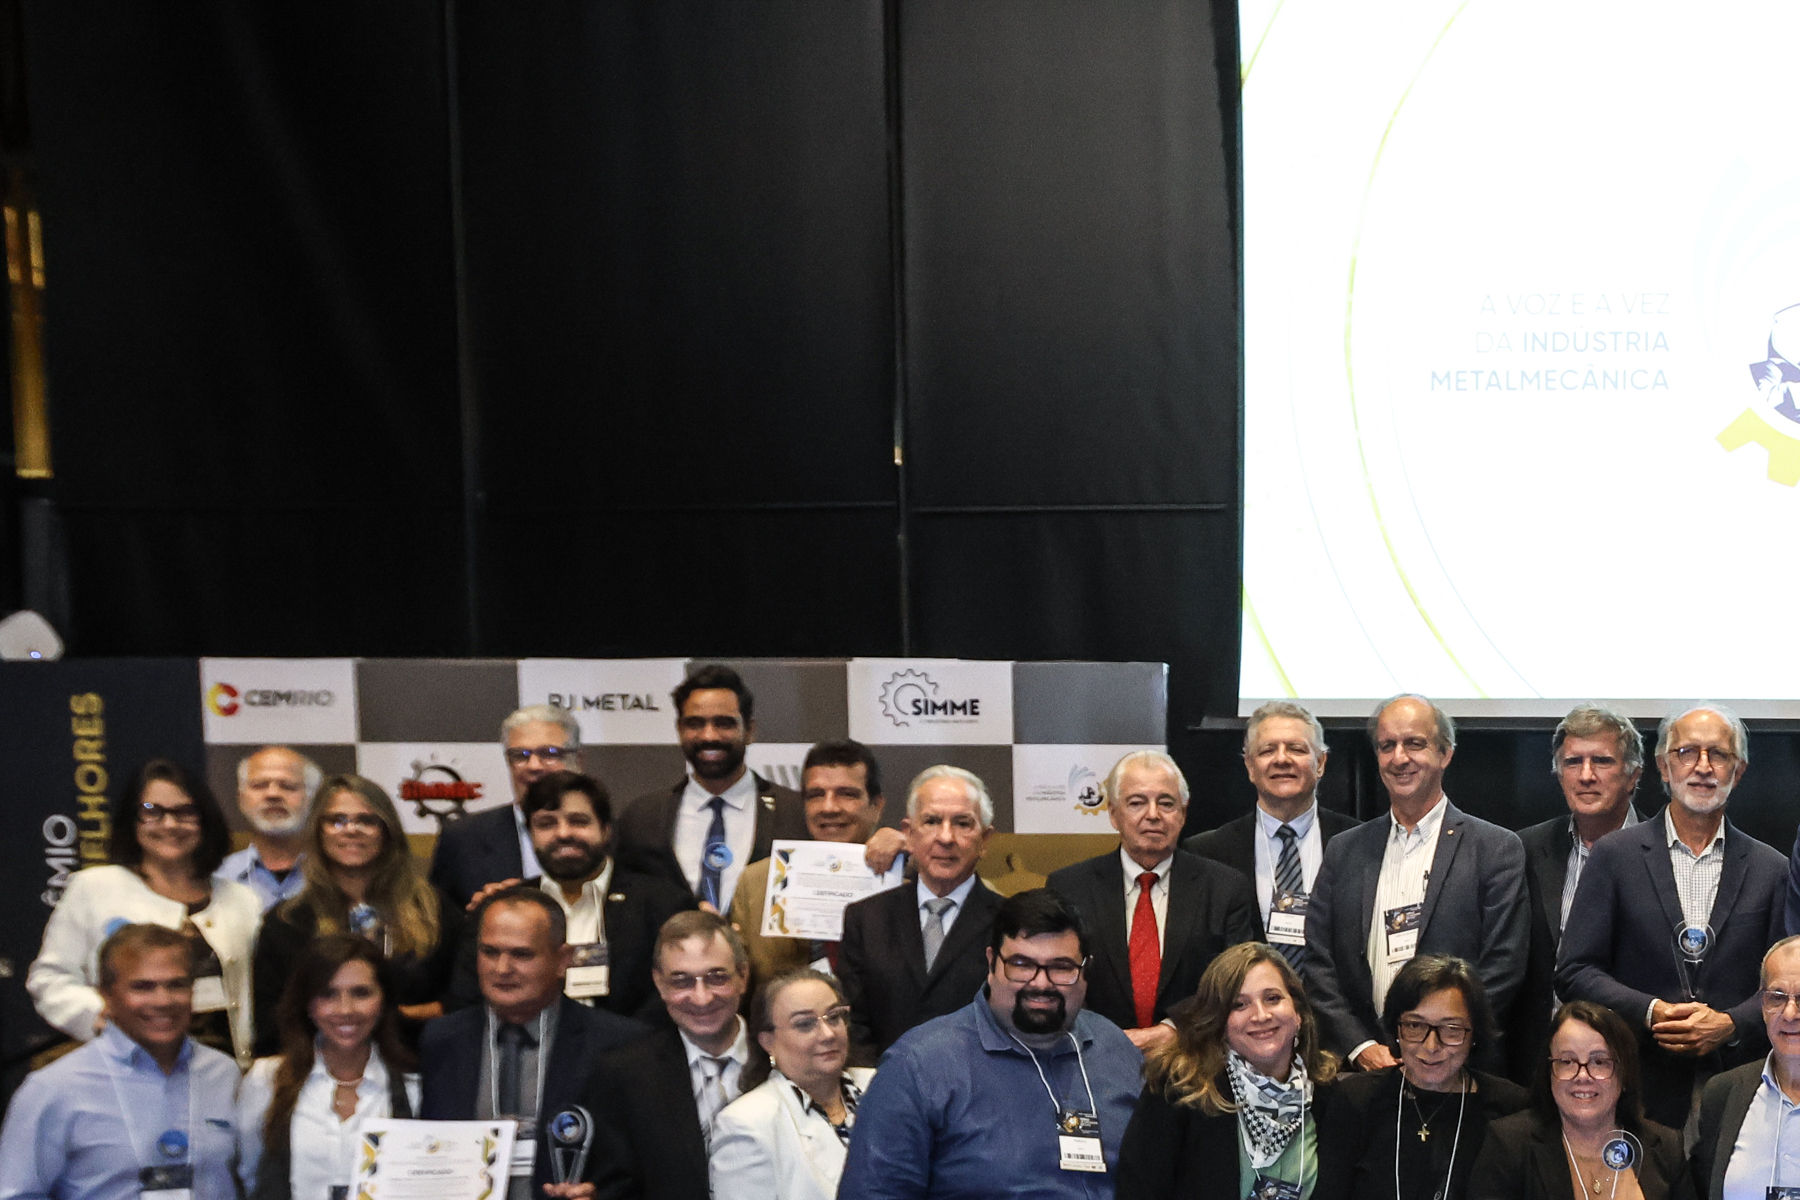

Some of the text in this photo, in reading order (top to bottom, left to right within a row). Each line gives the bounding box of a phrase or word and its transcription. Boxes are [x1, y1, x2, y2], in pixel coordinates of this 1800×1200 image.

[1479, 292, 1670, 316] A VOZ E A VEZ
[1475, 324, 1671, 354] DA INDÚSTRIA
[1429, 362, 1671, 392] METALMECÂNICA
[911, 698, 980, 716] SIMME
[70, 692, 112, 869] ELHORES
